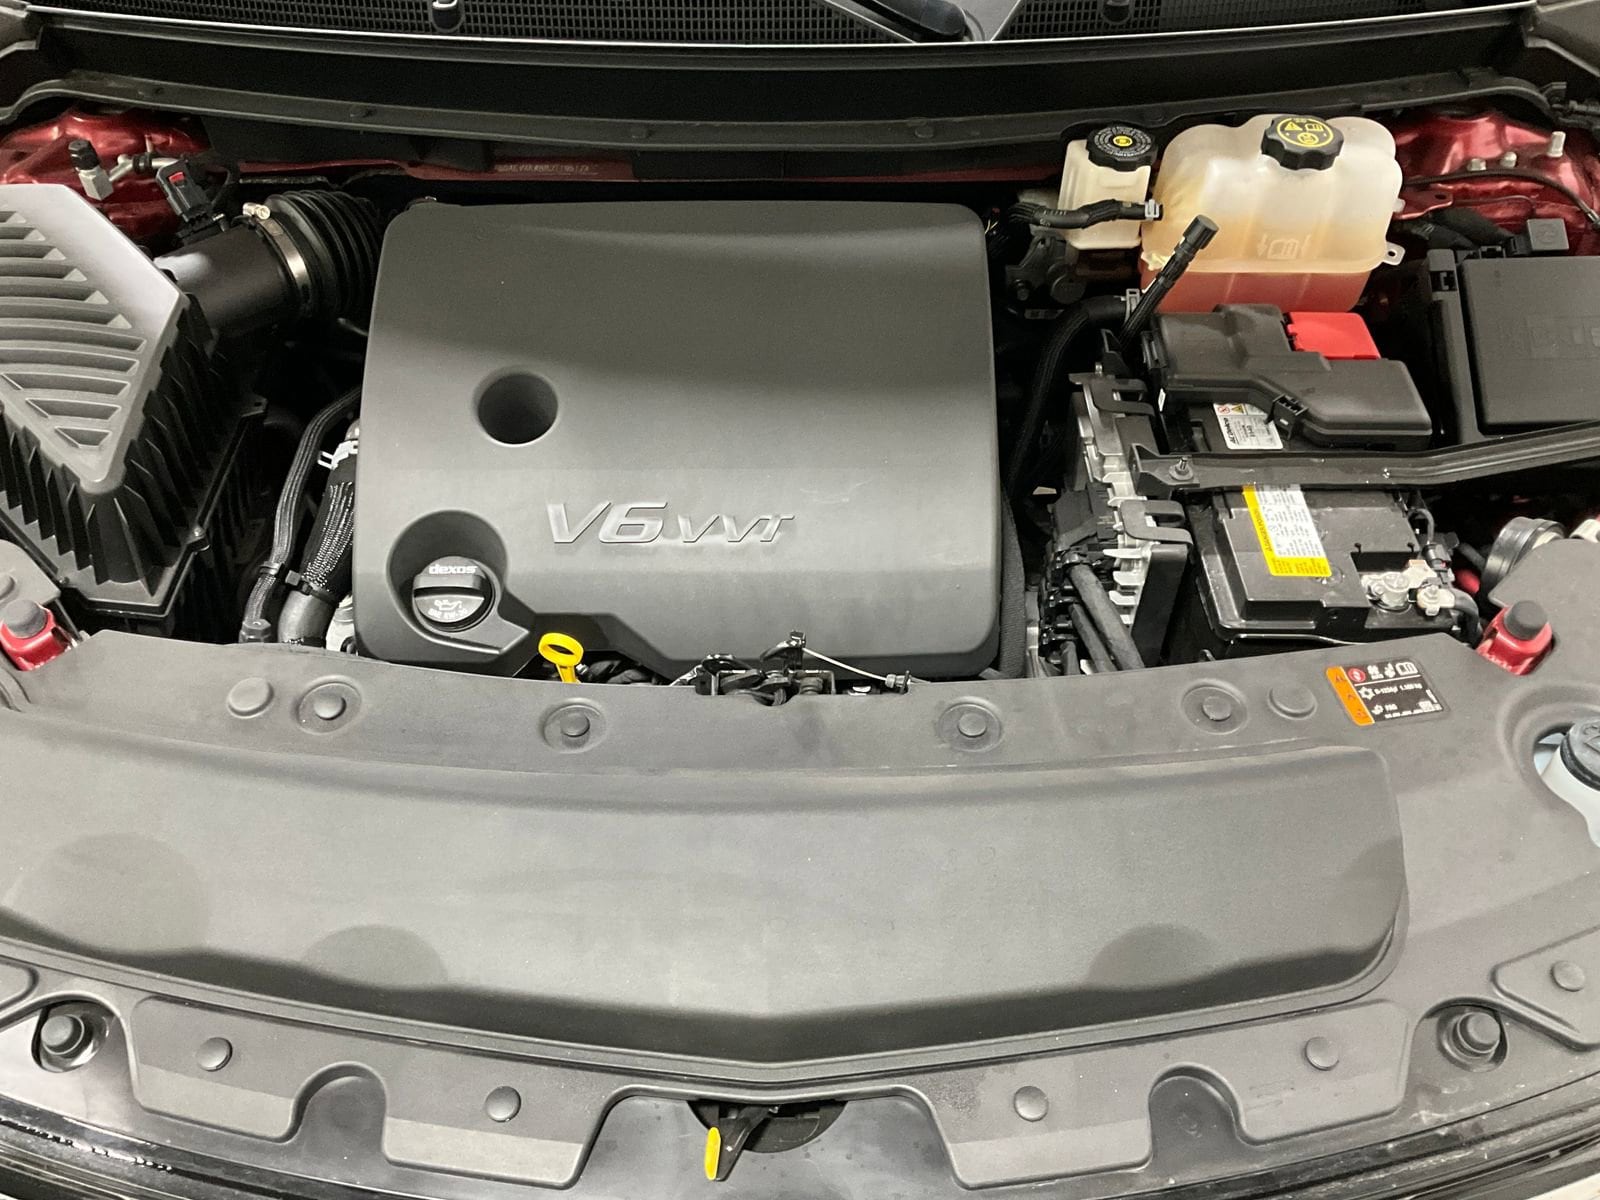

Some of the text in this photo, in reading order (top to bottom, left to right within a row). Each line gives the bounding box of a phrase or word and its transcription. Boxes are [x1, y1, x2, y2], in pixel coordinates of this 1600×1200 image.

[547, 500, 796, 544] V6 VVT
[428, 564, 478, 575] dexos
